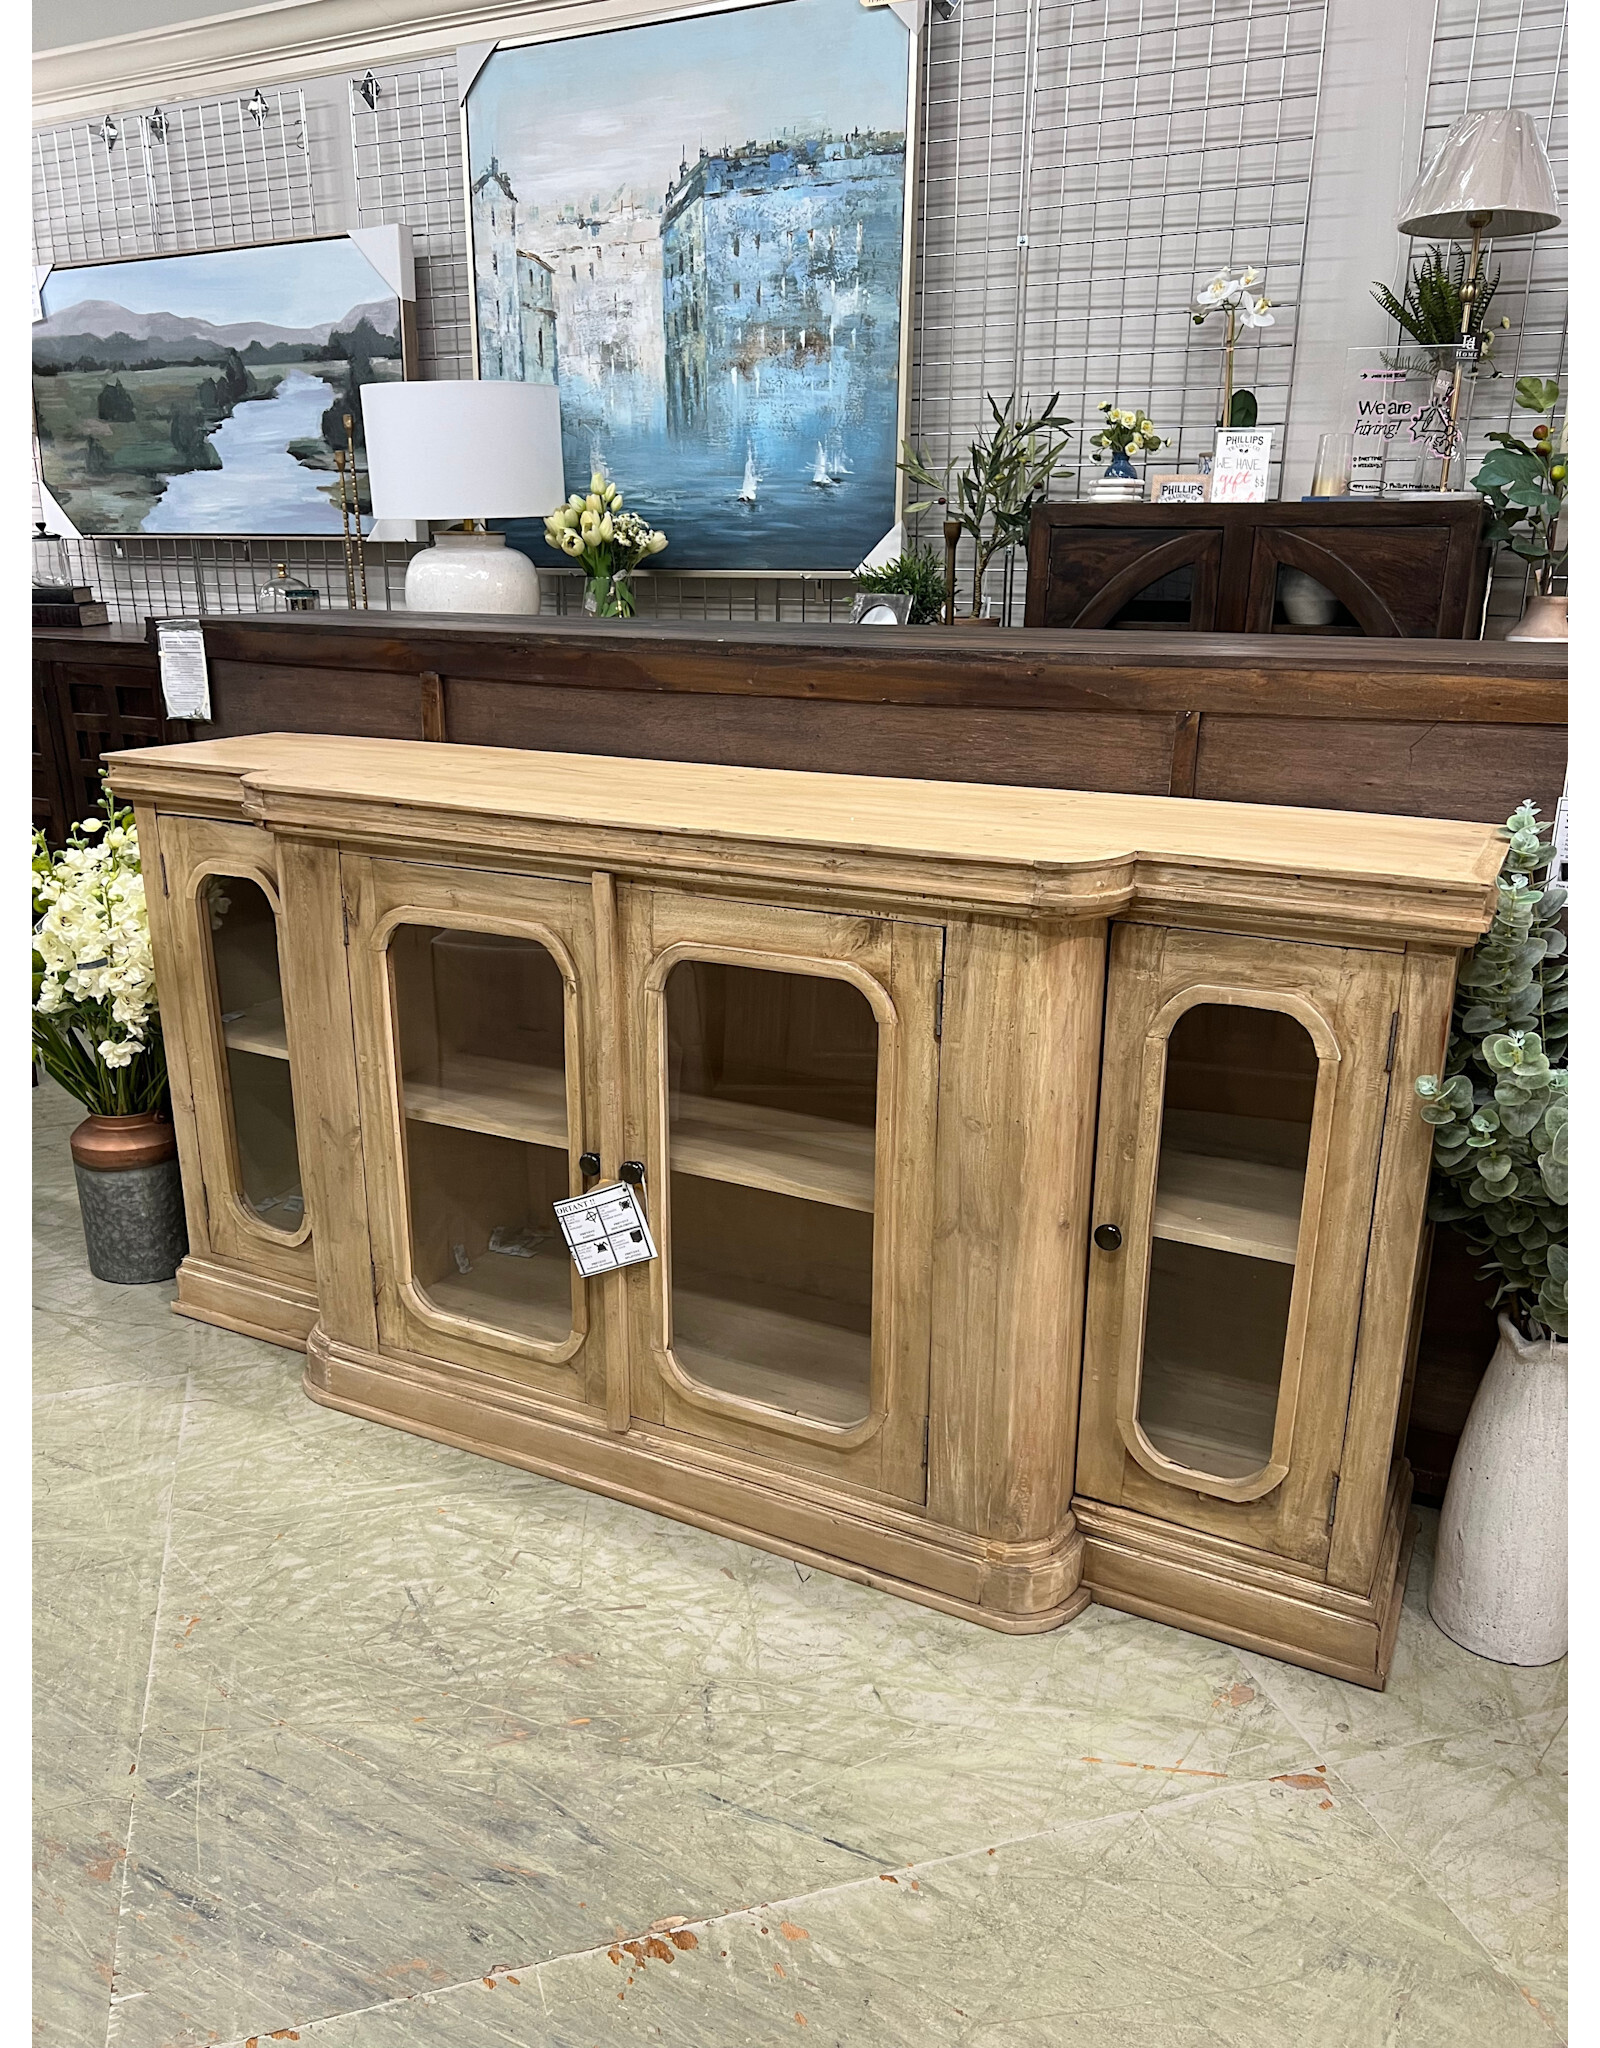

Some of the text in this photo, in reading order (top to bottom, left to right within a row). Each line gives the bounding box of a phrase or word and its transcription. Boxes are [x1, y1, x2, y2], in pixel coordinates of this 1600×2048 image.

[1359, 400, 1412, 415] We are
[1354, 419, 1402, 439] hiring!
[1226, 436, 1264, 445] PHILLIPS
[1216, 457, 1262, 470] WE HAVE
[1219, 471, 1252, 495] gift
[1162, 485, 1204, 495] PHILLIPS
[1164, 493, 1191, 502] TRADING
